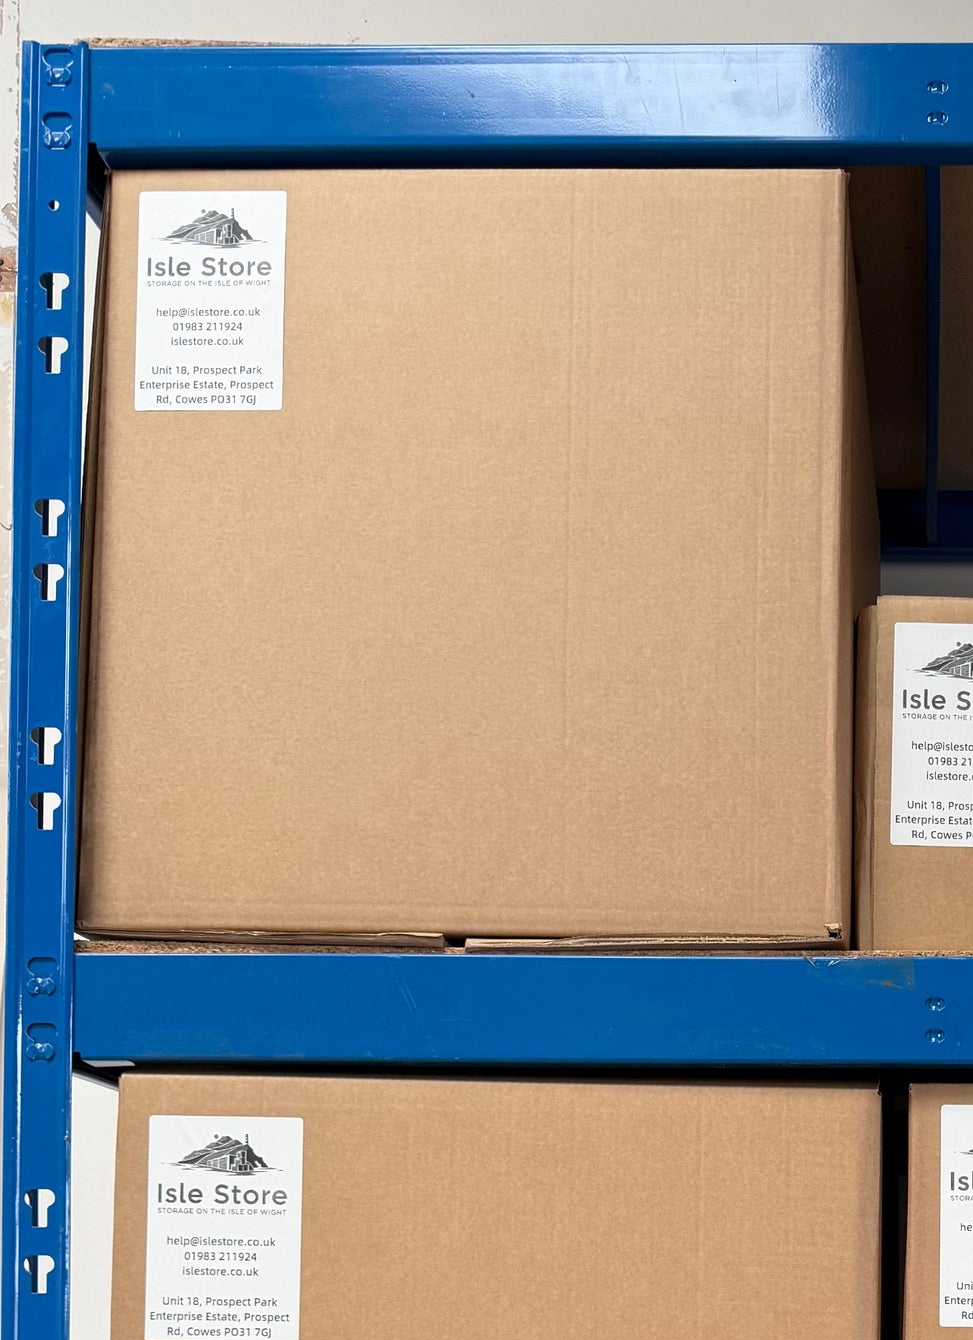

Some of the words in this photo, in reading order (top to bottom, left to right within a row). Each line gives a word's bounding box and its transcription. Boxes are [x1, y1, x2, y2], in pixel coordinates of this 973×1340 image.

[147, 256, 191, 276] Isle
[201, 256, 272, 276] Store
[157, 307, 260, 318] help@islestore.co.uk
[173, 322, 203, 331] 01983
[206, 322, 242, 331] 211924
[171, 337, 244, 346] islestore.co.uk
[152, 366, 172, 374] Unit
[176, 366, 189, 376] 18,
[193, 366, 237, 376] Prospect
[240, 365, 262, 374] Park
[140, 380, 190, 391] Enterprise
[193, 381, 226, 390] Estate,
[230, 381, 273, 390] Prospect
[157, 395, 172, 404] Rd,
[175, 395, 208, 404] Cowes
[211, 395, 236, 404] PO31
[240, 395, 256, 405] 7GJ
[902, 688, 946, 710] Isle
[928, 757, 958, 766] 01983
[907, 801, 927, 810] Unit
[931, 801, 945, 811] 18,
[895, 815, 945, 826] Enterprise
[912, 830, 927, 840] Rd,
[931, 831, 963, 839] Cowes
[158, 1182, 203, 1203] Isle
[214, 1184, 288, 1205] Store
[167, 1236, 276, 1247] help@islestore.co.uk
[184, 1252, 216, 1261] 01983
[219, 1252, 257, 1261] 211924
[183, 1266, 258, 1276] islestore.co.uk
[163, 1296, 184, 1305] Unit
[187, 1297, 202, 1307] 18,
[206, 1297, 251, 1308] Prospect
[254, 1298, 278, 1307] Park
[150, 1312, 203, 1322] Enterprise
[206, 1312, 240, 1322] Estate,
[244, 1313, 289, 1323] Prospect
[167, 1327, 184, 1337] Rd,
[187, 1327, 221, 1336] Cowes
[225, 1328, 250, 1336] PO31
[255, 1328, 271, 1338] 7GJ
